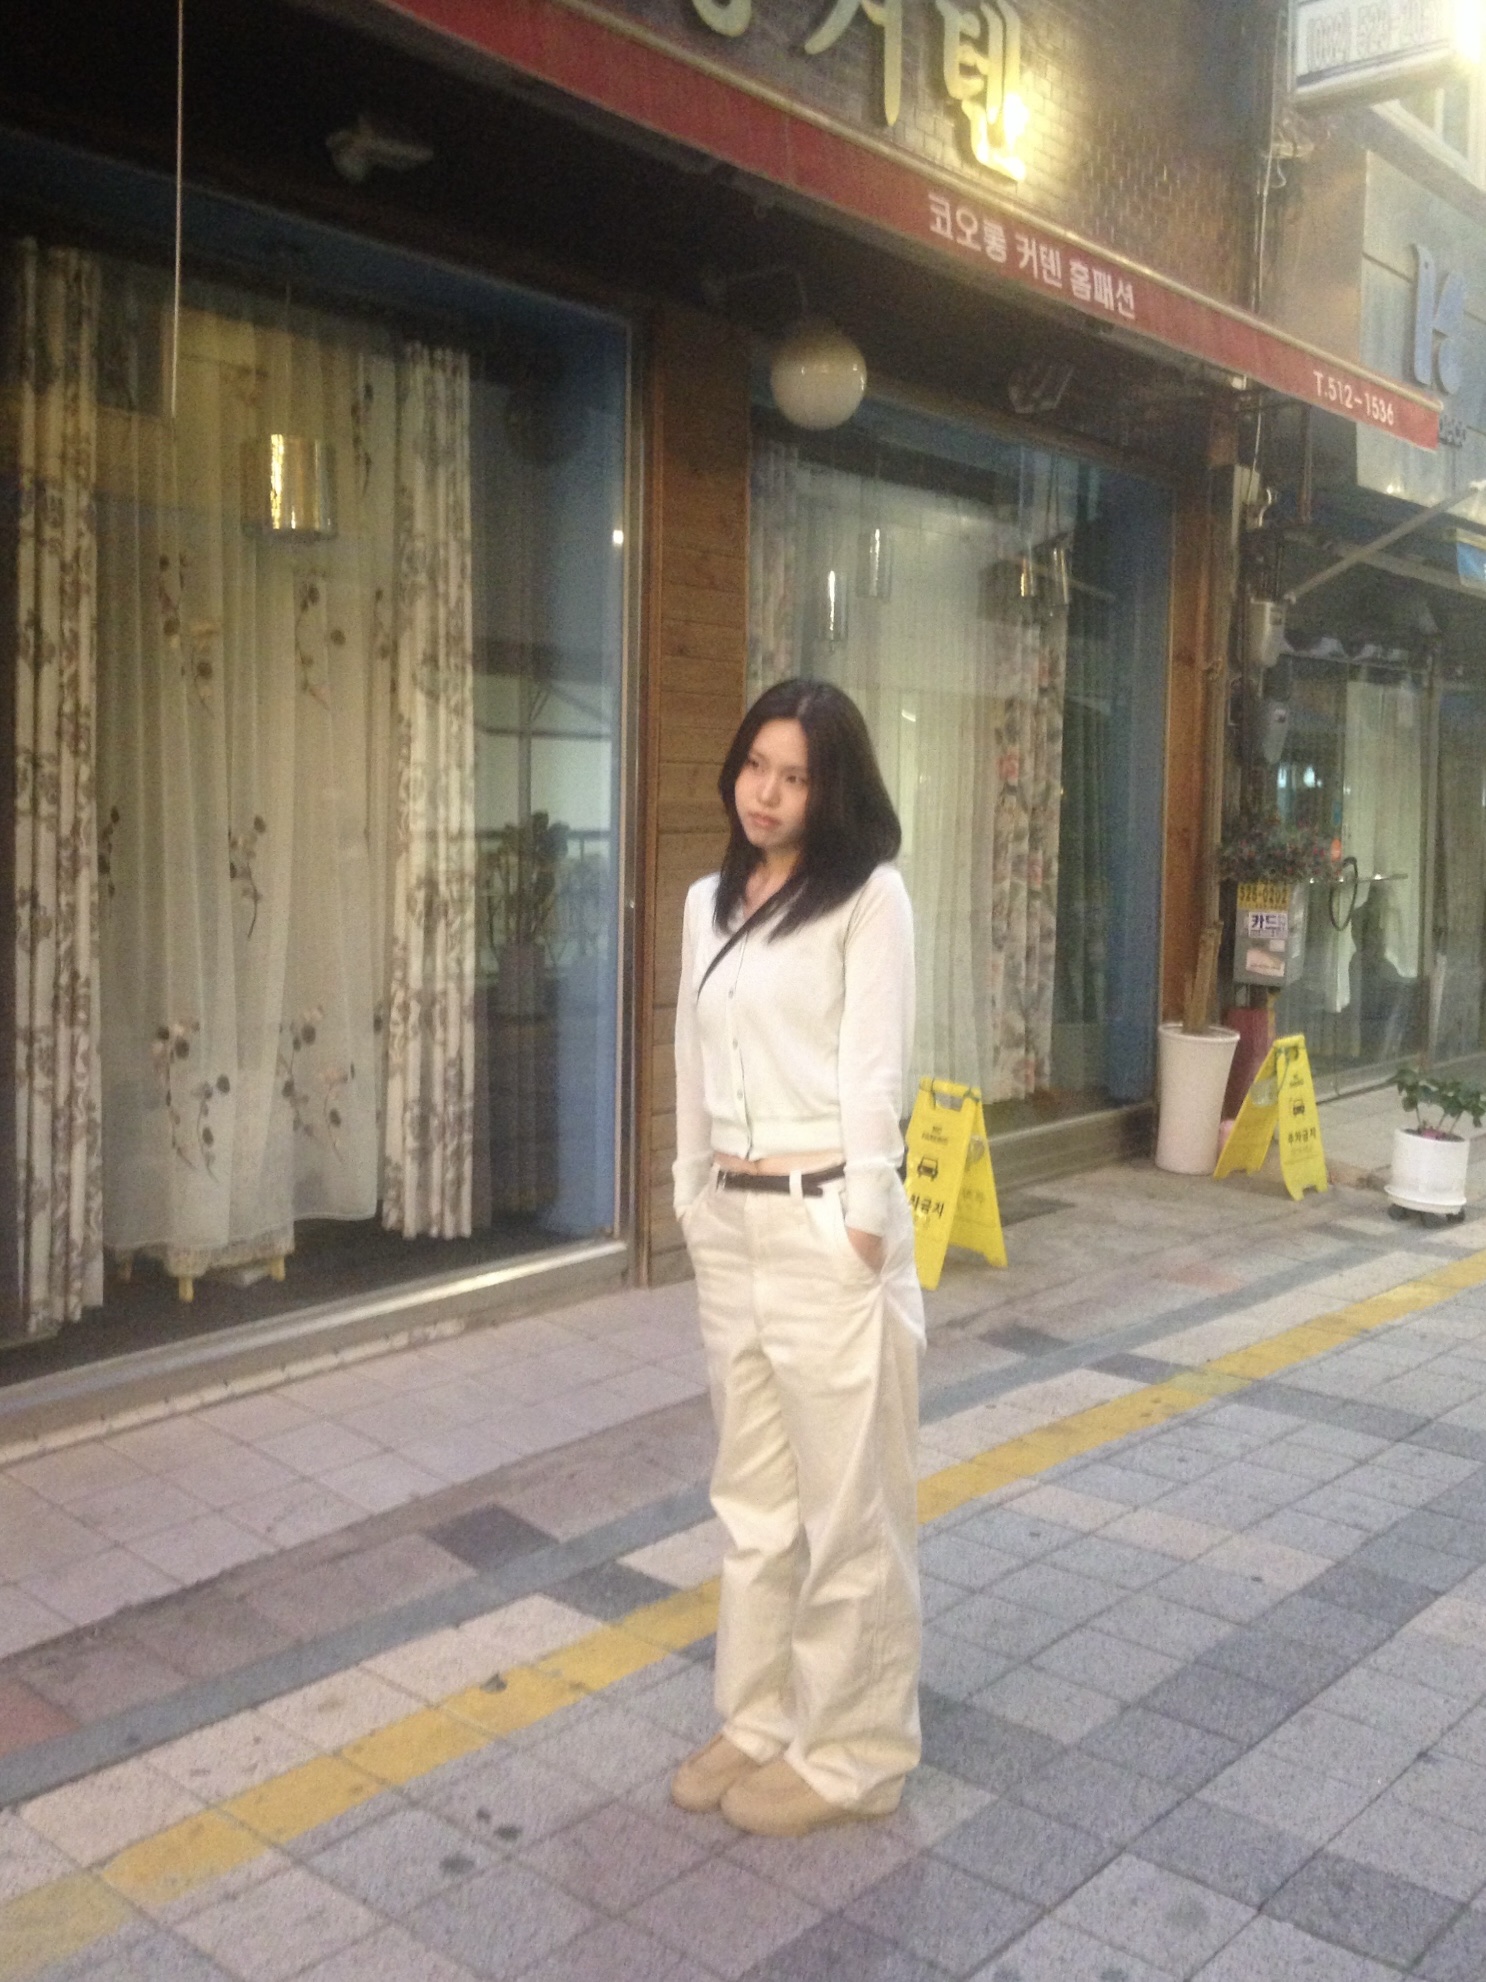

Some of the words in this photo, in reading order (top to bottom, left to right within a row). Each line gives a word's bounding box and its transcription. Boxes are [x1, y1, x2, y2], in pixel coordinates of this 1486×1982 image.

[928, 192, 1008, 264] 코오롱
[1015, 232, 1063, 289] 커텐
[1069, 257, 1136, 320] 홈패션
[1313, 369, 1395, 426] T.512-1536
